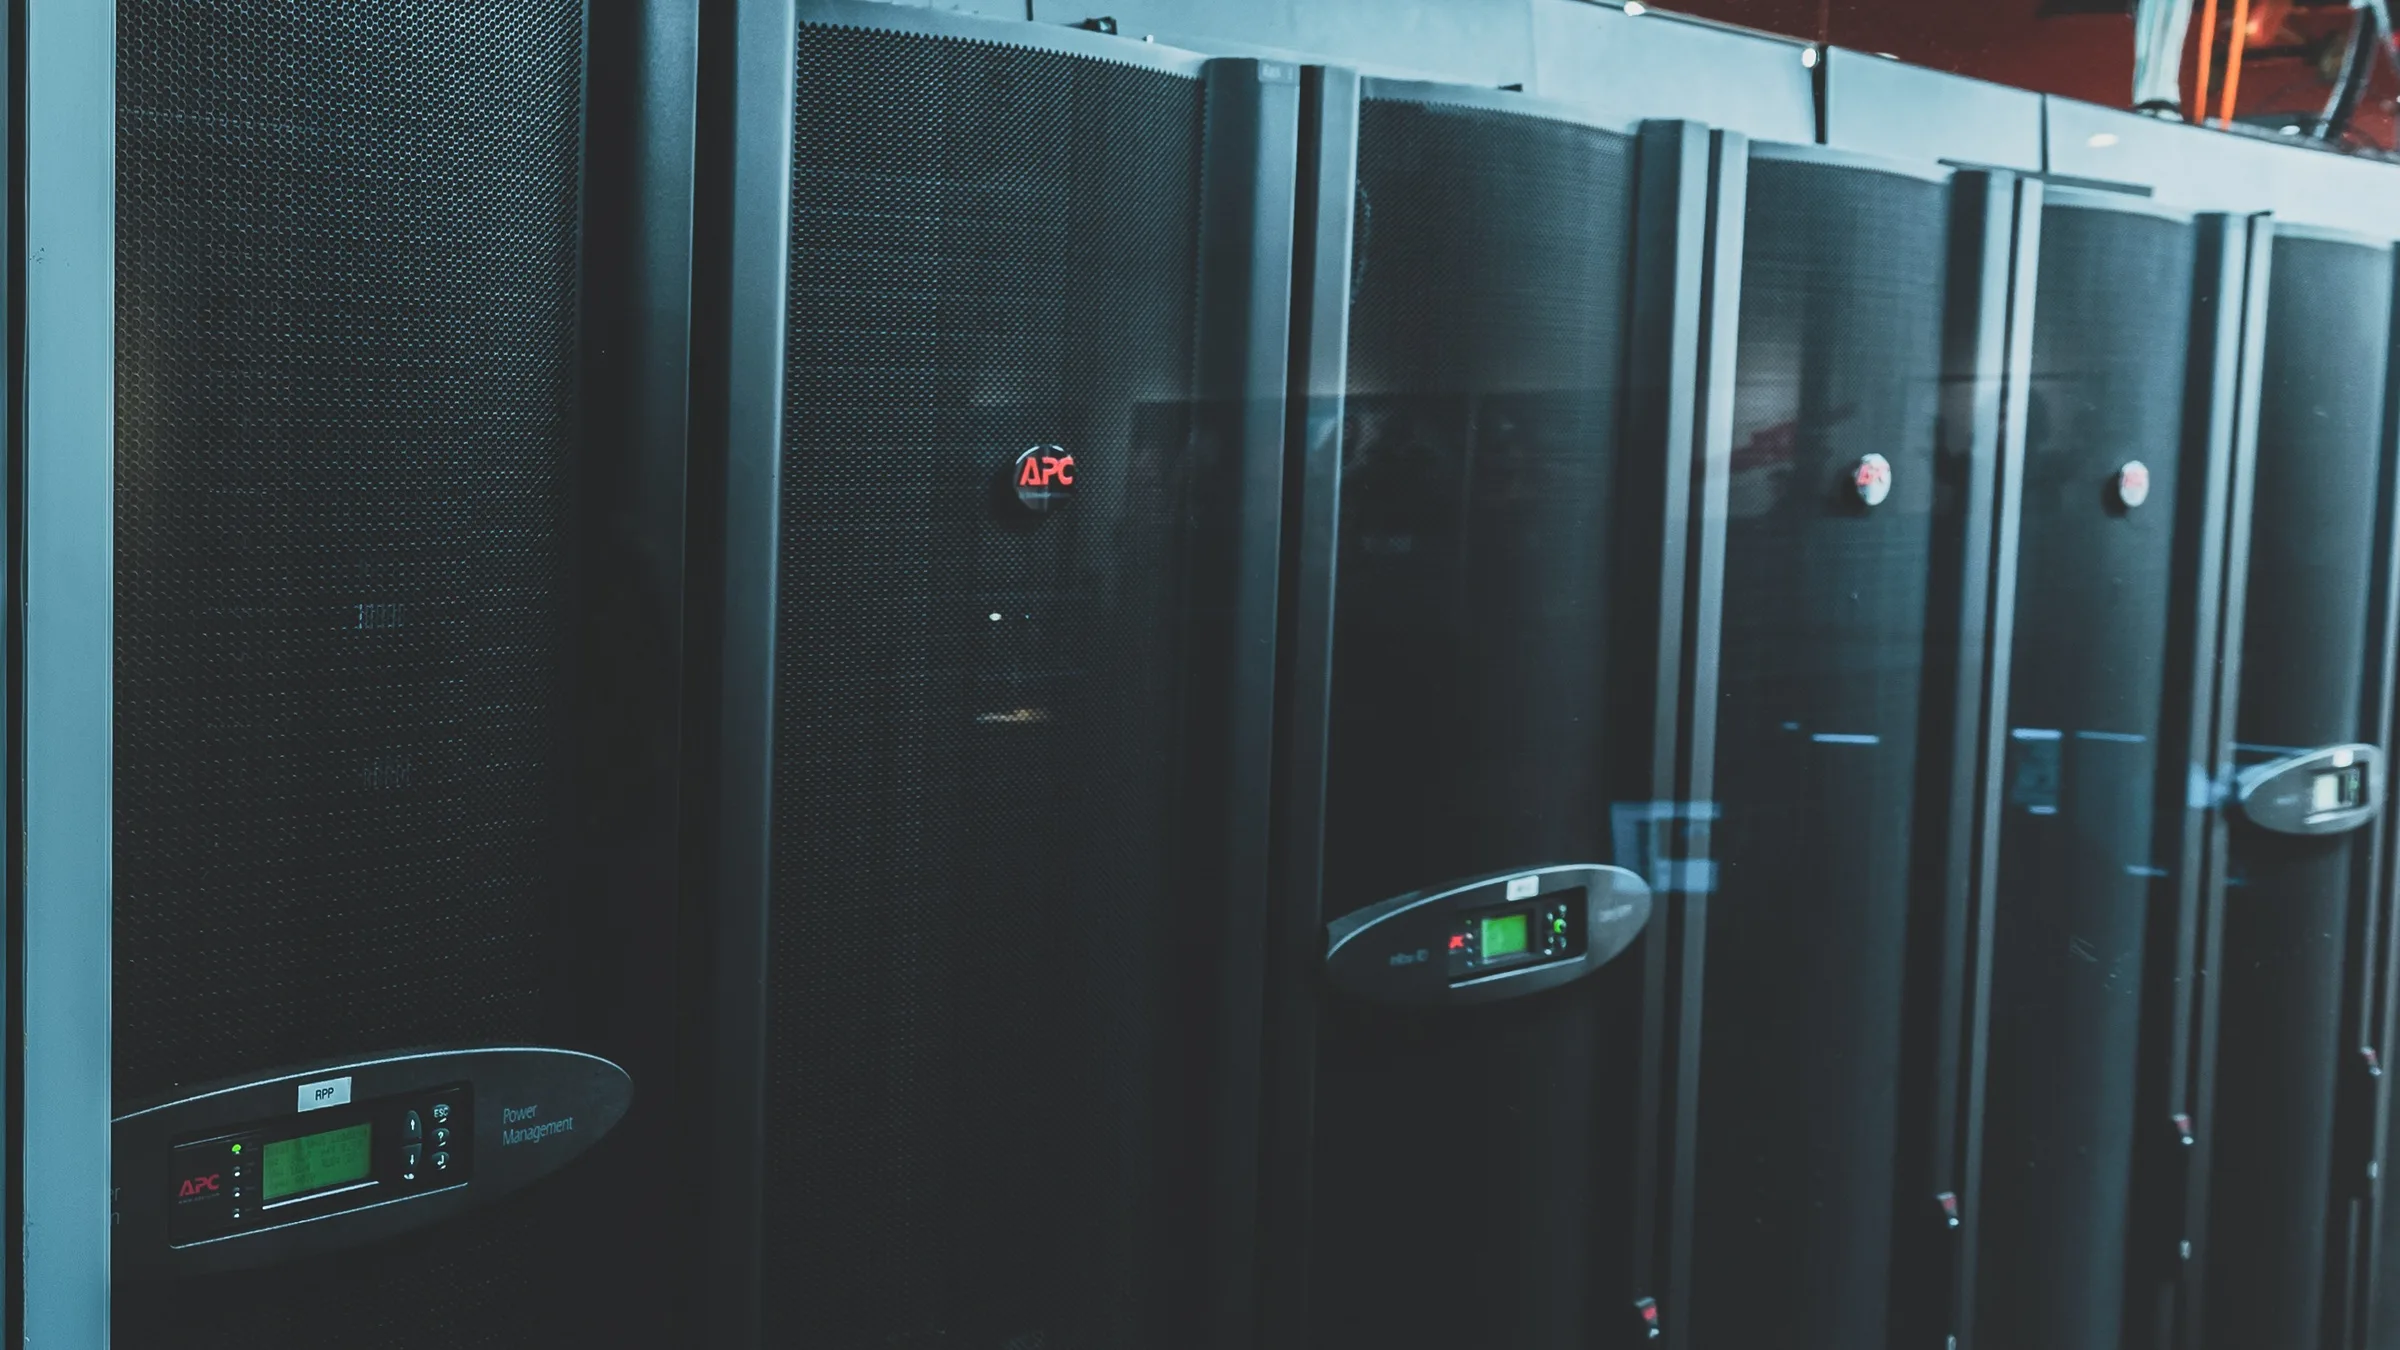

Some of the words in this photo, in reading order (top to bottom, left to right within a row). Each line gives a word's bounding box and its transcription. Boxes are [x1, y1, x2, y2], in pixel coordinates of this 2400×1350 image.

[1019, 456, 1075, 487] APC
[315, 1087, 334, 1101] RPP
[433, 1106, 450, 1118] ESC
[503, 1104, 538, 1124] Power
[502, 1116, 573, 1146] Management
[179, 1174, 220, 1197] APC
